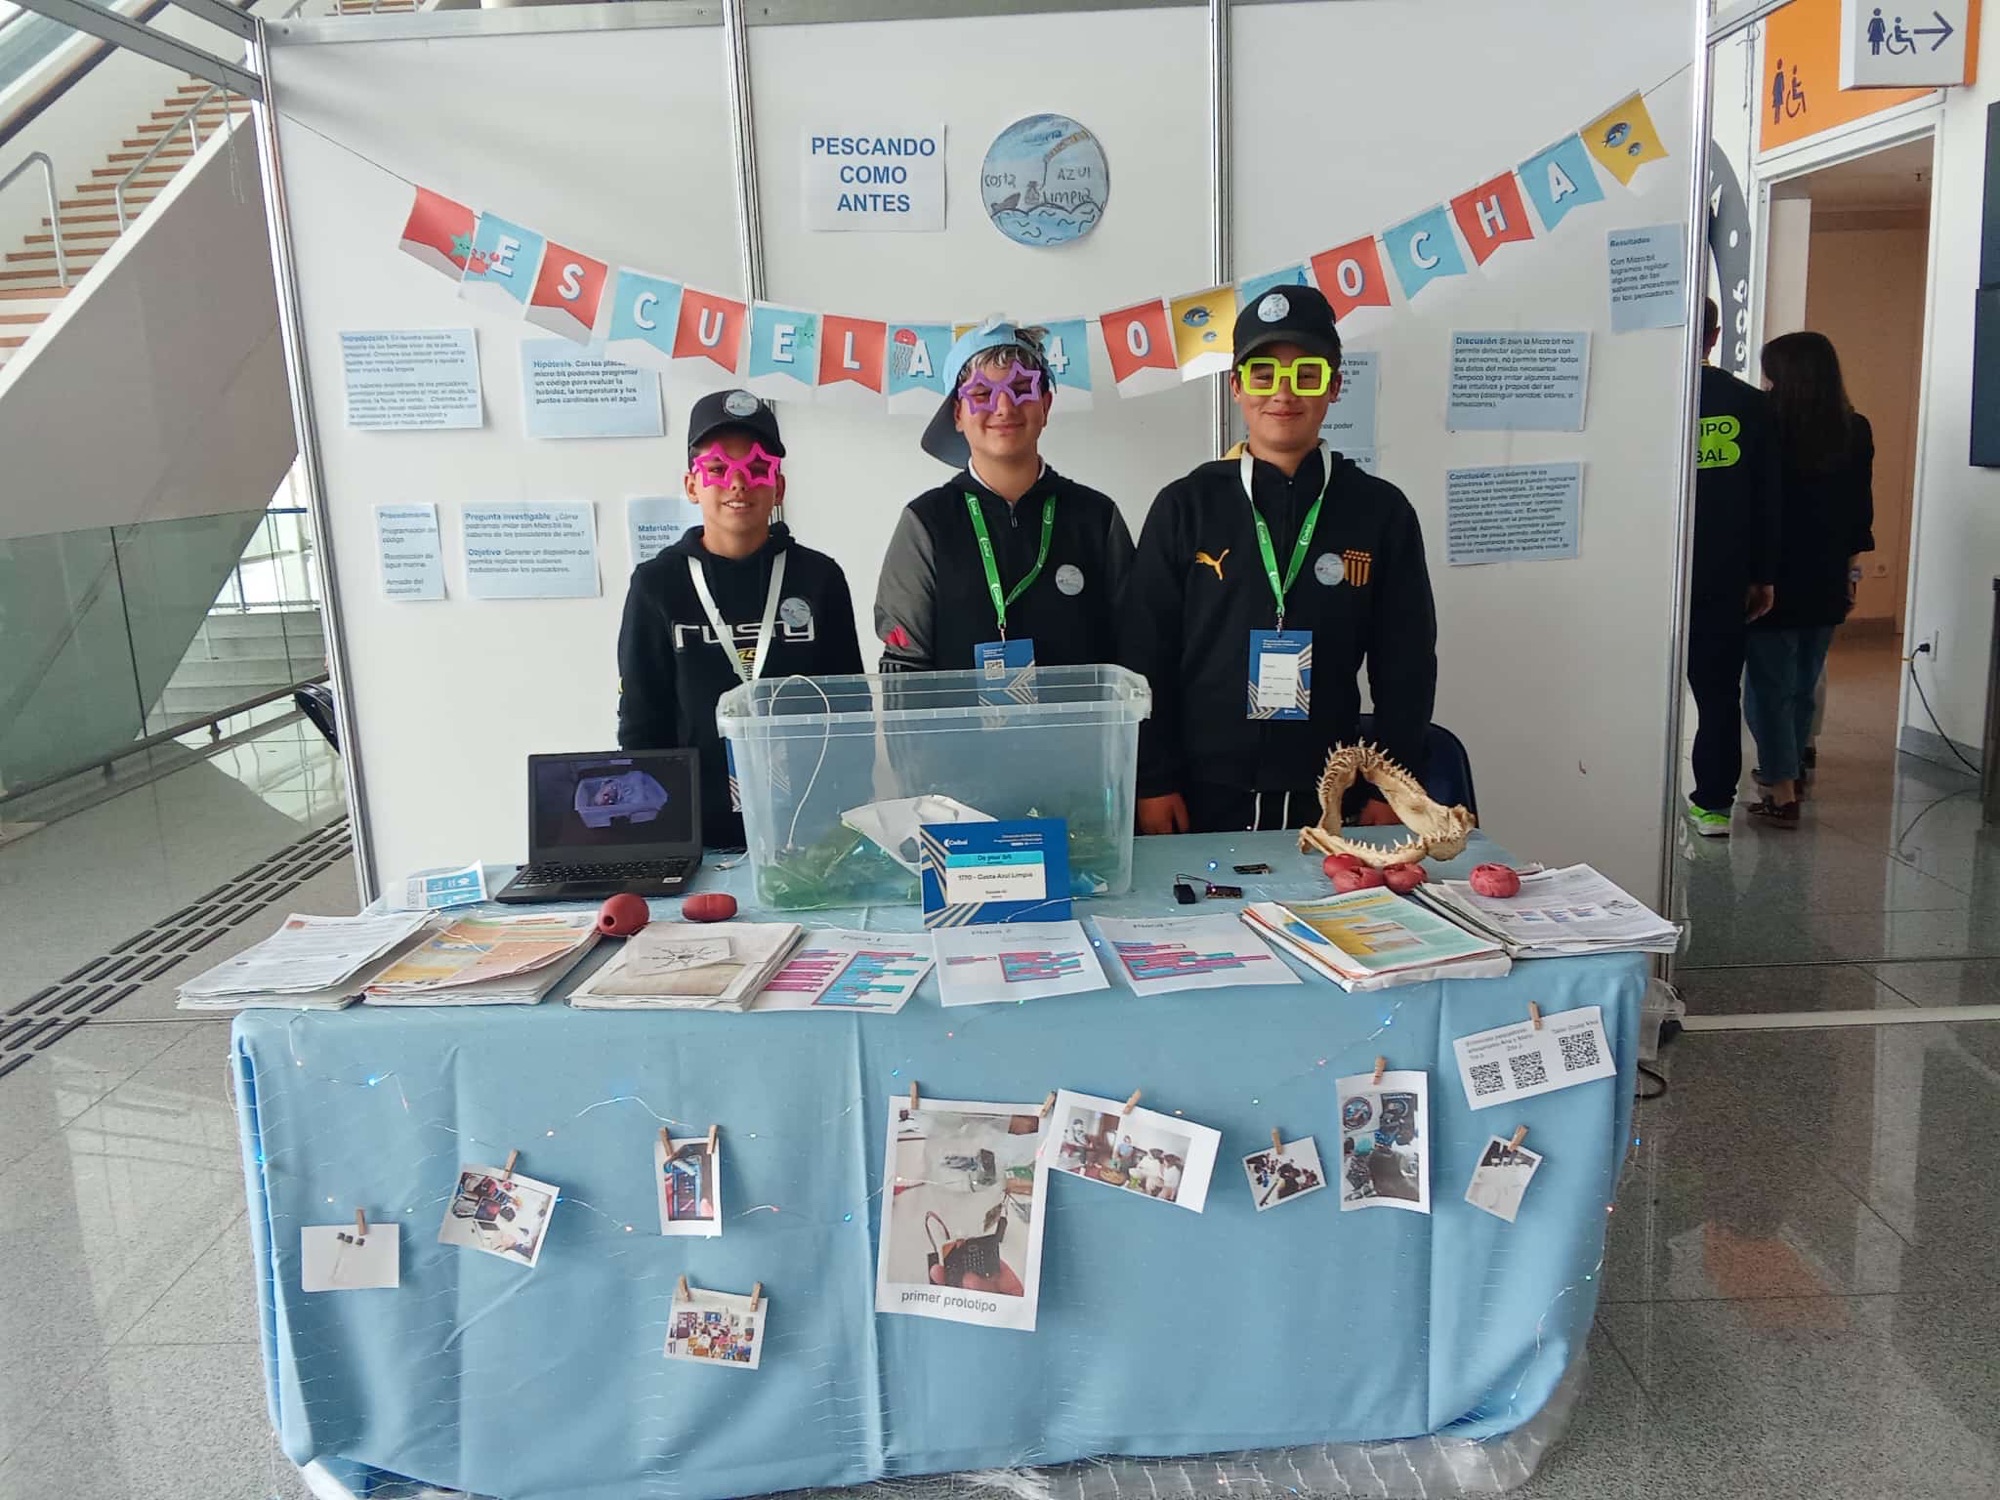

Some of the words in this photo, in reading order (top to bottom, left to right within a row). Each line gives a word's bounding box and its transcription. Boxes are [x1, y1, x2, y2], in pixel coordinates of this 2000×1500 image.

[812, 137, 936, 156] PESCANDO
[840, 165, 907, 184] COMO
[837, 194, 910, 212] ANTES
[1336, 161, 1578, 298] OCHA
[1611, 258, 1625, 266] Con
[1454, 347, 1480, 355] permite
[1510, 347, 1537, 355] algunos
[1512, 356, 1537, 364] permite
[1454, 373, 1484, 381] Tampoco
[1485, 374, 1502, 382] logra
[1523, 374, 1550, 382] algunos
[546, 379, 570, 387] código
[1505, 383, 1530, 391] propios
[576, 388, 618, 396] temperatura
[536, 397, 561, 405] puntos
[1700, 421, 1733, 437] IPO
[1697, 448, 1728, 463] BAL
[465, 513, 501, 522] Pregunta
[901, 1290, 941, 1303] primer
[944, 1296, 997, 1312] prototipo
